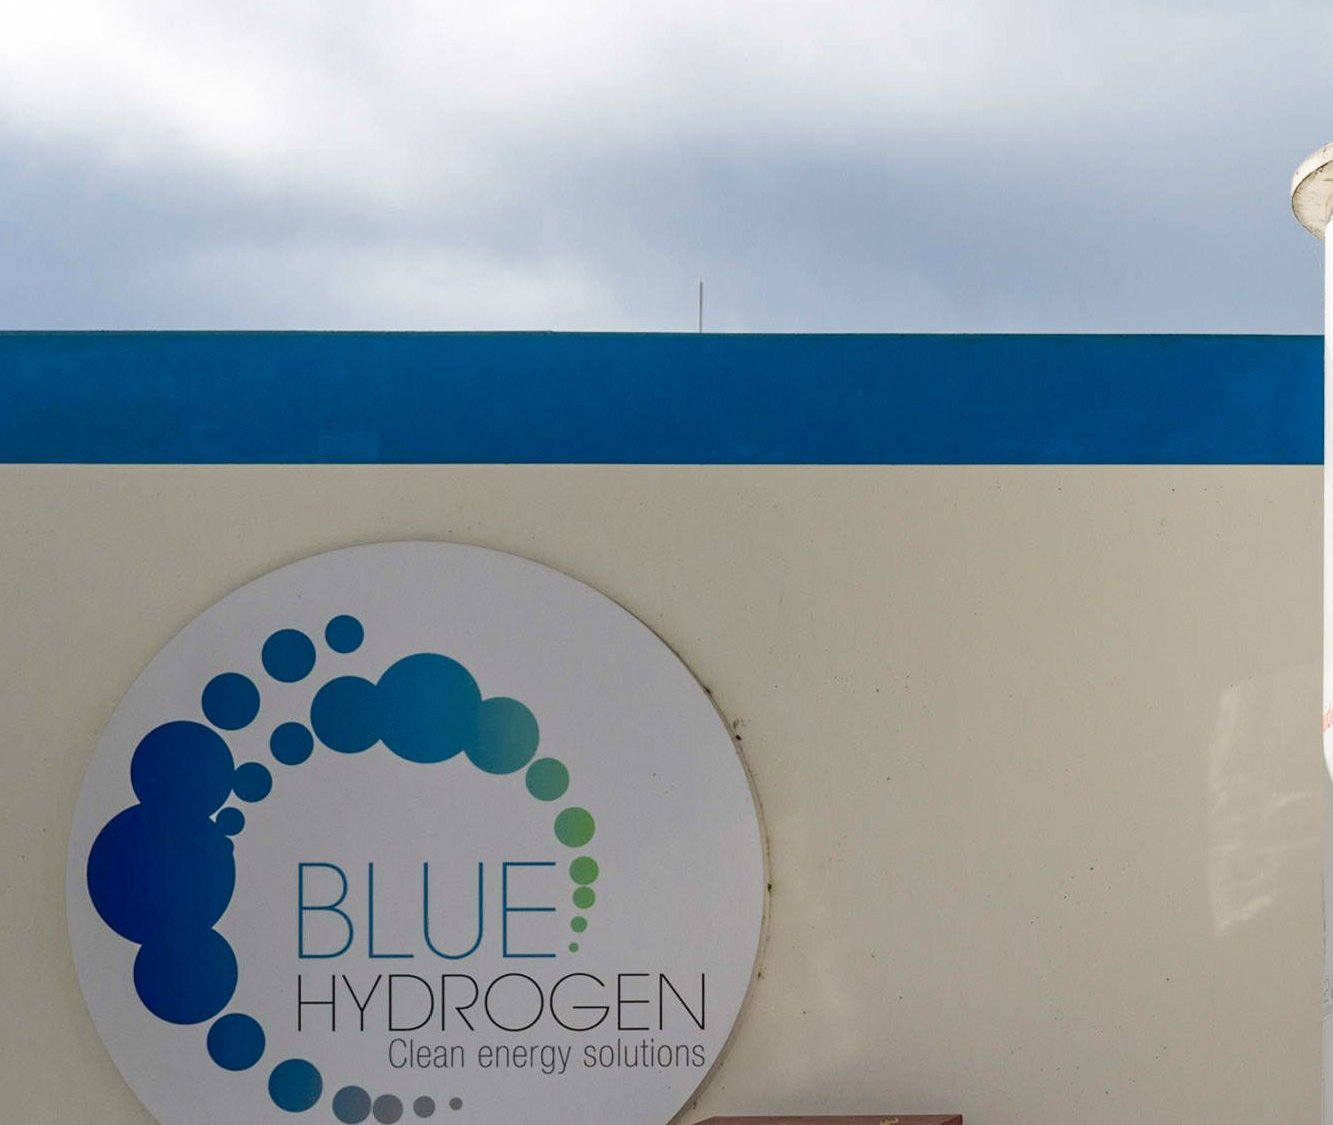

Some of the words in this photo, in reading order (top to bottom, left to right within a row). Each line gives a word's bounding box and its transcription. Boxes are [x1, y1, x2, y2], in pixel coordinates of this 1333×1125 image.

[297, 861, 556, 960] BLUE
[297, 972, 706, 1033] HYDROGEN
[389, 1038, 465, 1069] Clean
[478, 1045, 572, 1075] energy
[583, 1038, 705, 1069] solutions
